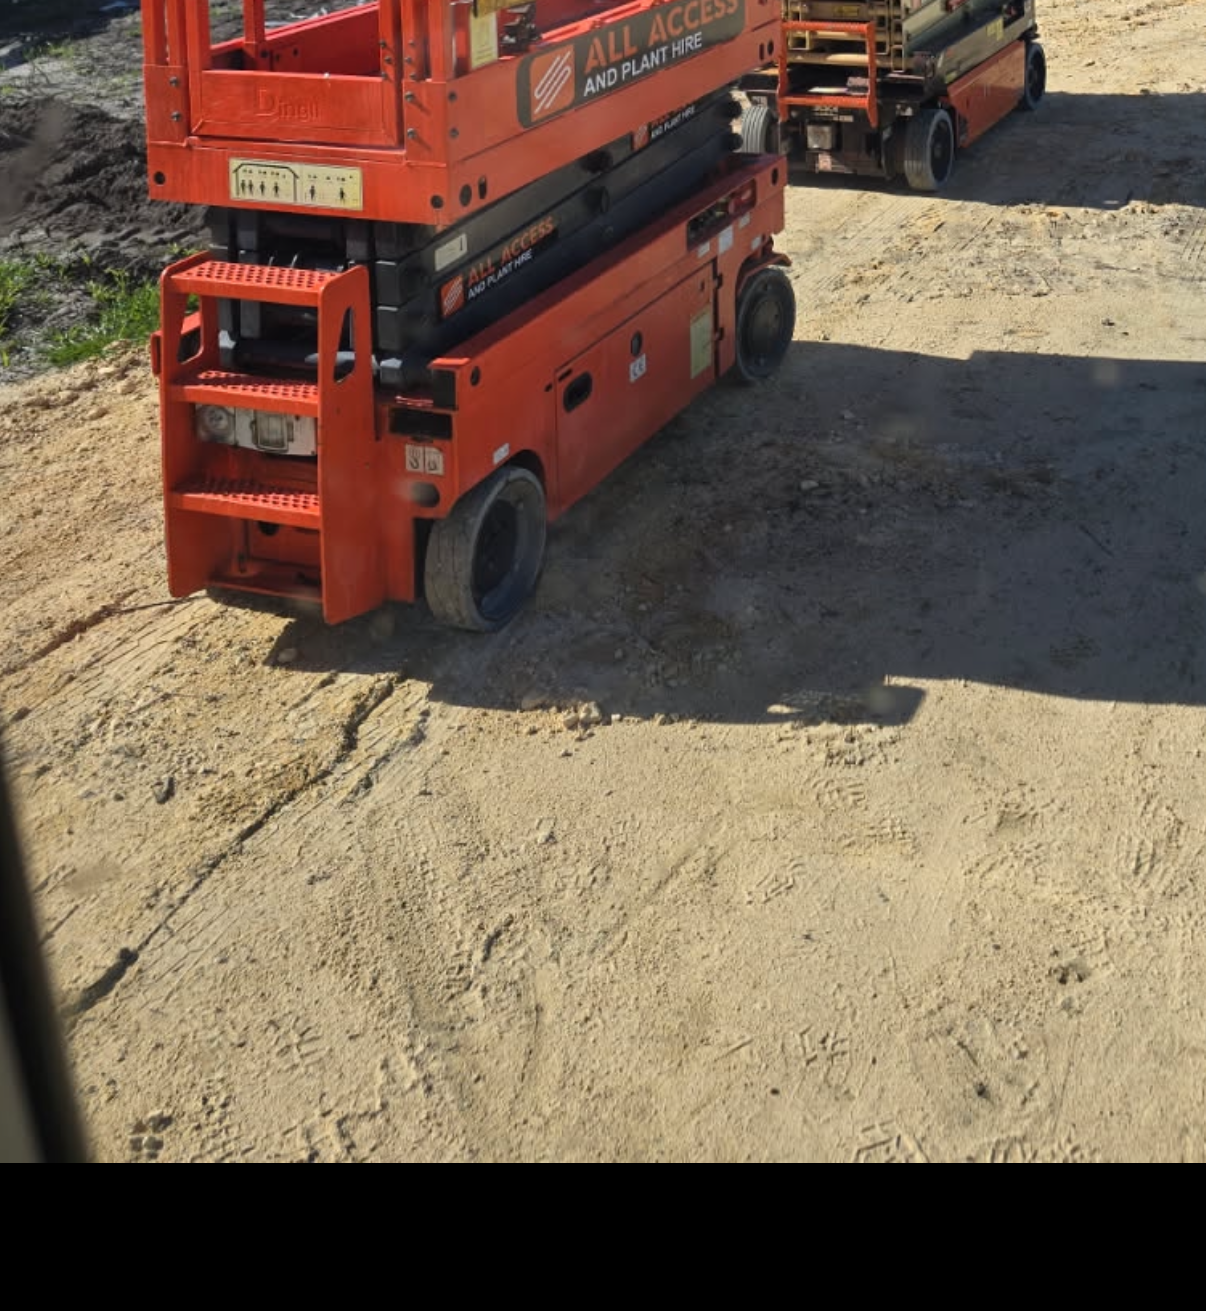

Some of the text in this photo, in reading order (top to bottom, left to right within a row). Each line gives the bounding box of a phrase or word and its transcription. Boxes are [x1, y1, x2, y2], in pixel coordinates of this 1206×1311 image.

[583, 31, 703, 97] AND PLANT HIRE
[584, 24, 638, 75] ALL
[255, 88, 319, 123] Dingli
[468, 216, 554, 288] ALL ACCESS
[468, 248, 534, 301] AND PLANT HIRE
